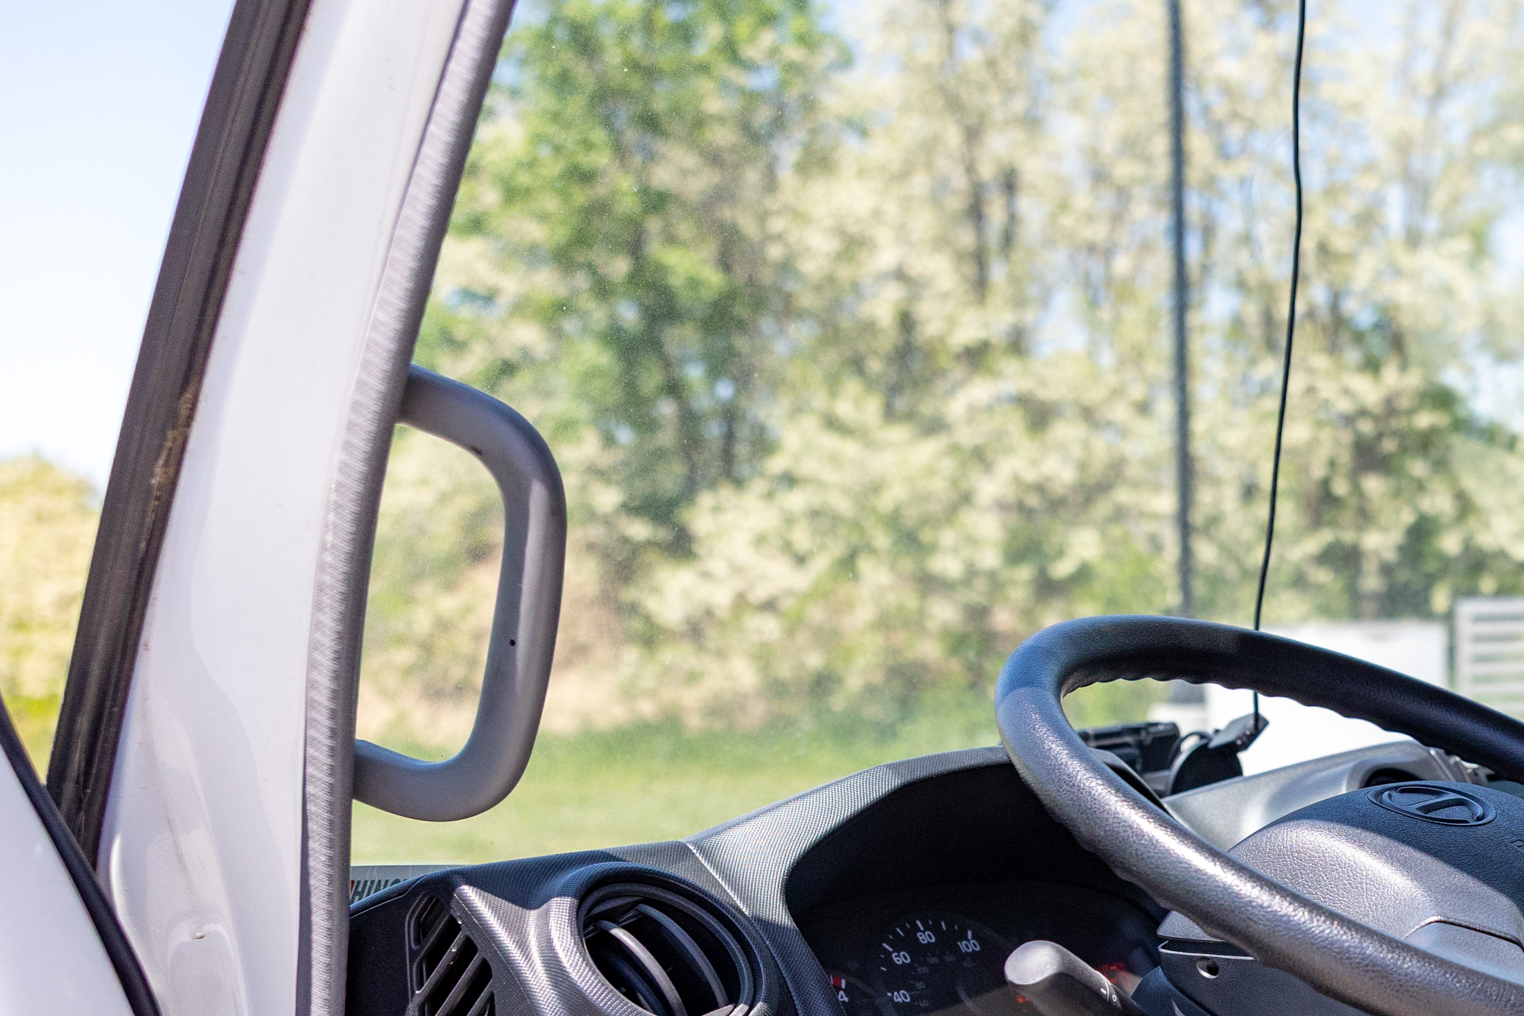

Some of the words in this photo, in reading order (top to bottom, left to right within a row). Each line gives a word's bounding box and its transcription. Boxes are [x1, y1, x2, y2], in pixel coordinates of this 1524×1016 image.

[917, 930, 936, 944] 80
[957, 939, 981, 953] 100
[892, 951, 911, 965] 60
[837, 990, 849, 1003] 4
[893, 989, 911, 1003] 40
